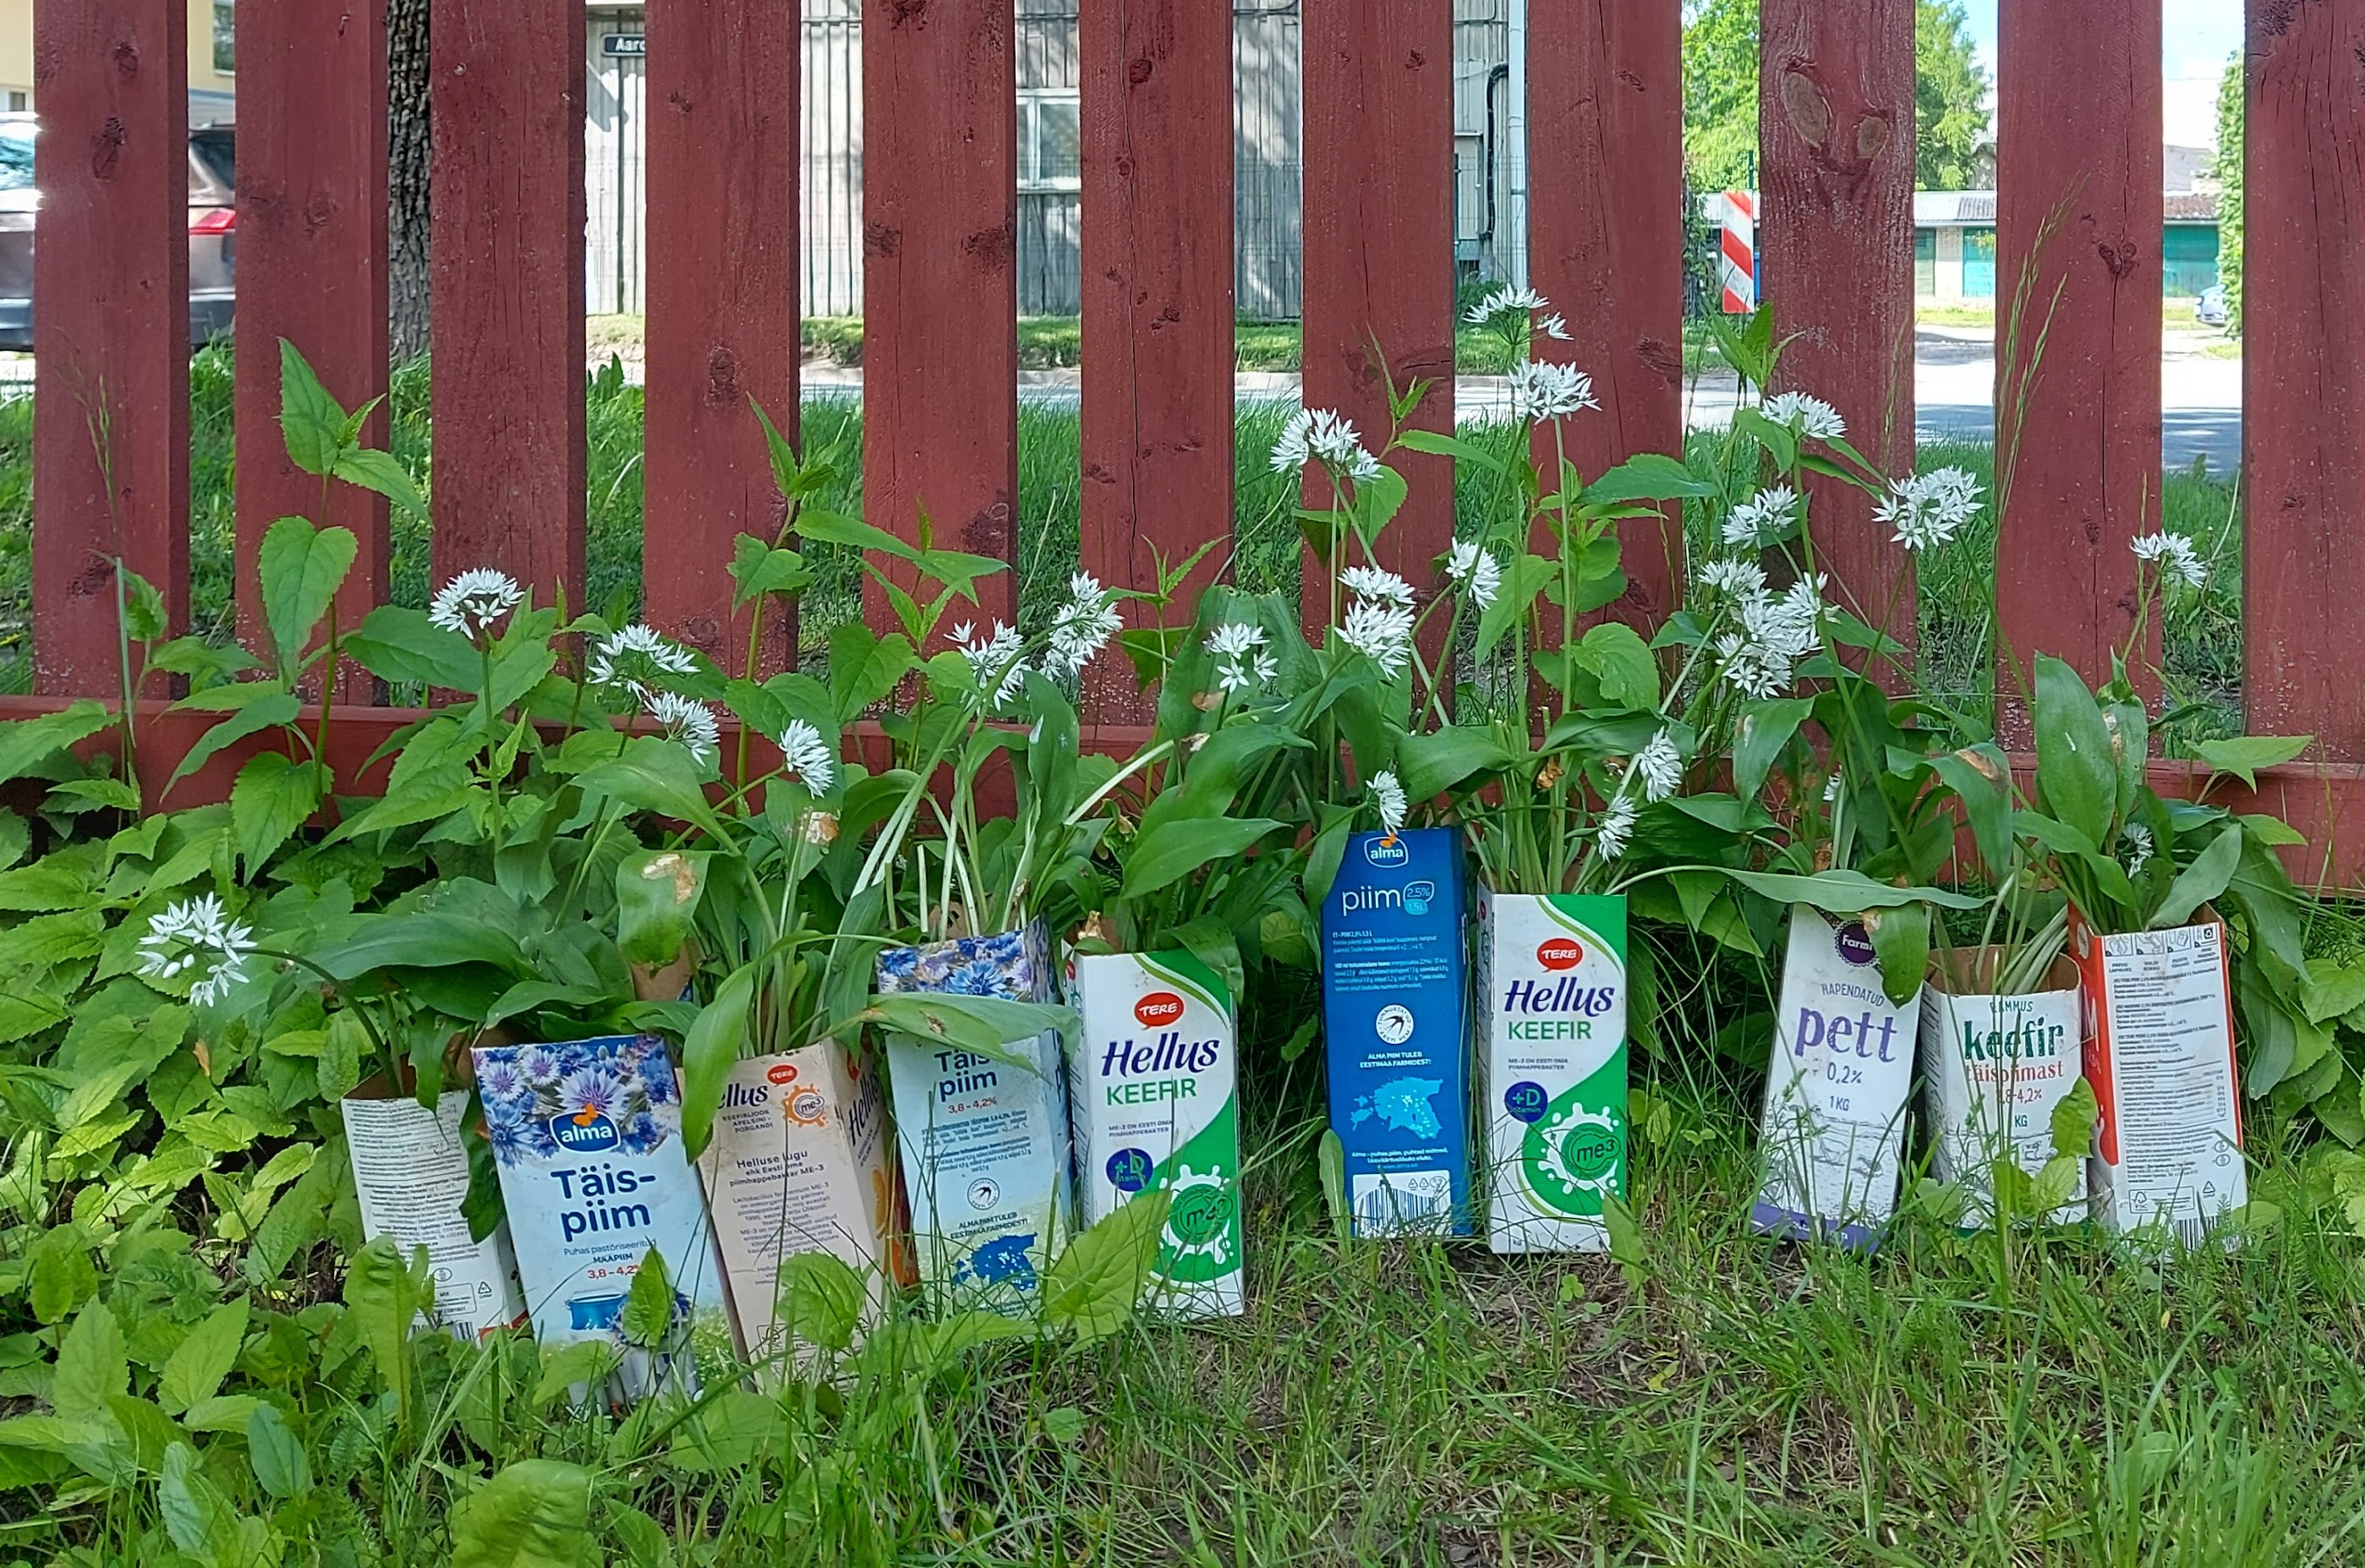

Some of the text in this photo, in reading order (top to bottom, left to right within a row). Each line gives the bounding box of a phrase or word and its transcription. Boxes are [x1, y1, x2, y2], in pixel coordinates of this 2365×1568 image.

[1370, 847, 1404, 859] alma
[1342, 886, 1400, 916] piim
[1842, 933, 1873, 952] Farmi
[1541, 948, 1577, 959] TERE
[1504, 976, 1615, 1018] Hellus
[1821, 983, 1885, 1007] HAPENDATUD
[1139, 1003, 1178, 1017] TERE
[1508, 1021, 1591, 1040] KEEFIR
[1794, 1007, 1897, 1063] pett
[1964, 1016, 2064, 1061] keefir
[1101, 1032, 1220, 1078] Hellus
[1827, 1062, 1863, 1084] 0,2%
[1966, 1061, 2064, 1085] täispimast
[939, 1070, 997, 1102] piim
[1107, 1078, 1197, 1106] KEEFIR
[948, 1103, 965, 1114] 3,8
[972, 1096, 997, 1108] 4,2%
[1835, 1098, 1850, 1112] KG
[561, 1125, 613, 1143] alma
[1577, 1139, 1614, 1162] me3
[736, 1156, 780, 1168] Helluse
[746, 1167, 760, 1176] ehk
[762, 1164, 783, 1173] Eesti
[801, 1164, 824, 1176] ME-3
[550, 1163, 656, 1199] Täis-
[561, 1199, 651, 1242] piim
[564, 1248, 590, 1256] Puhas
[588, 1269, 606, 1280] 3,8
